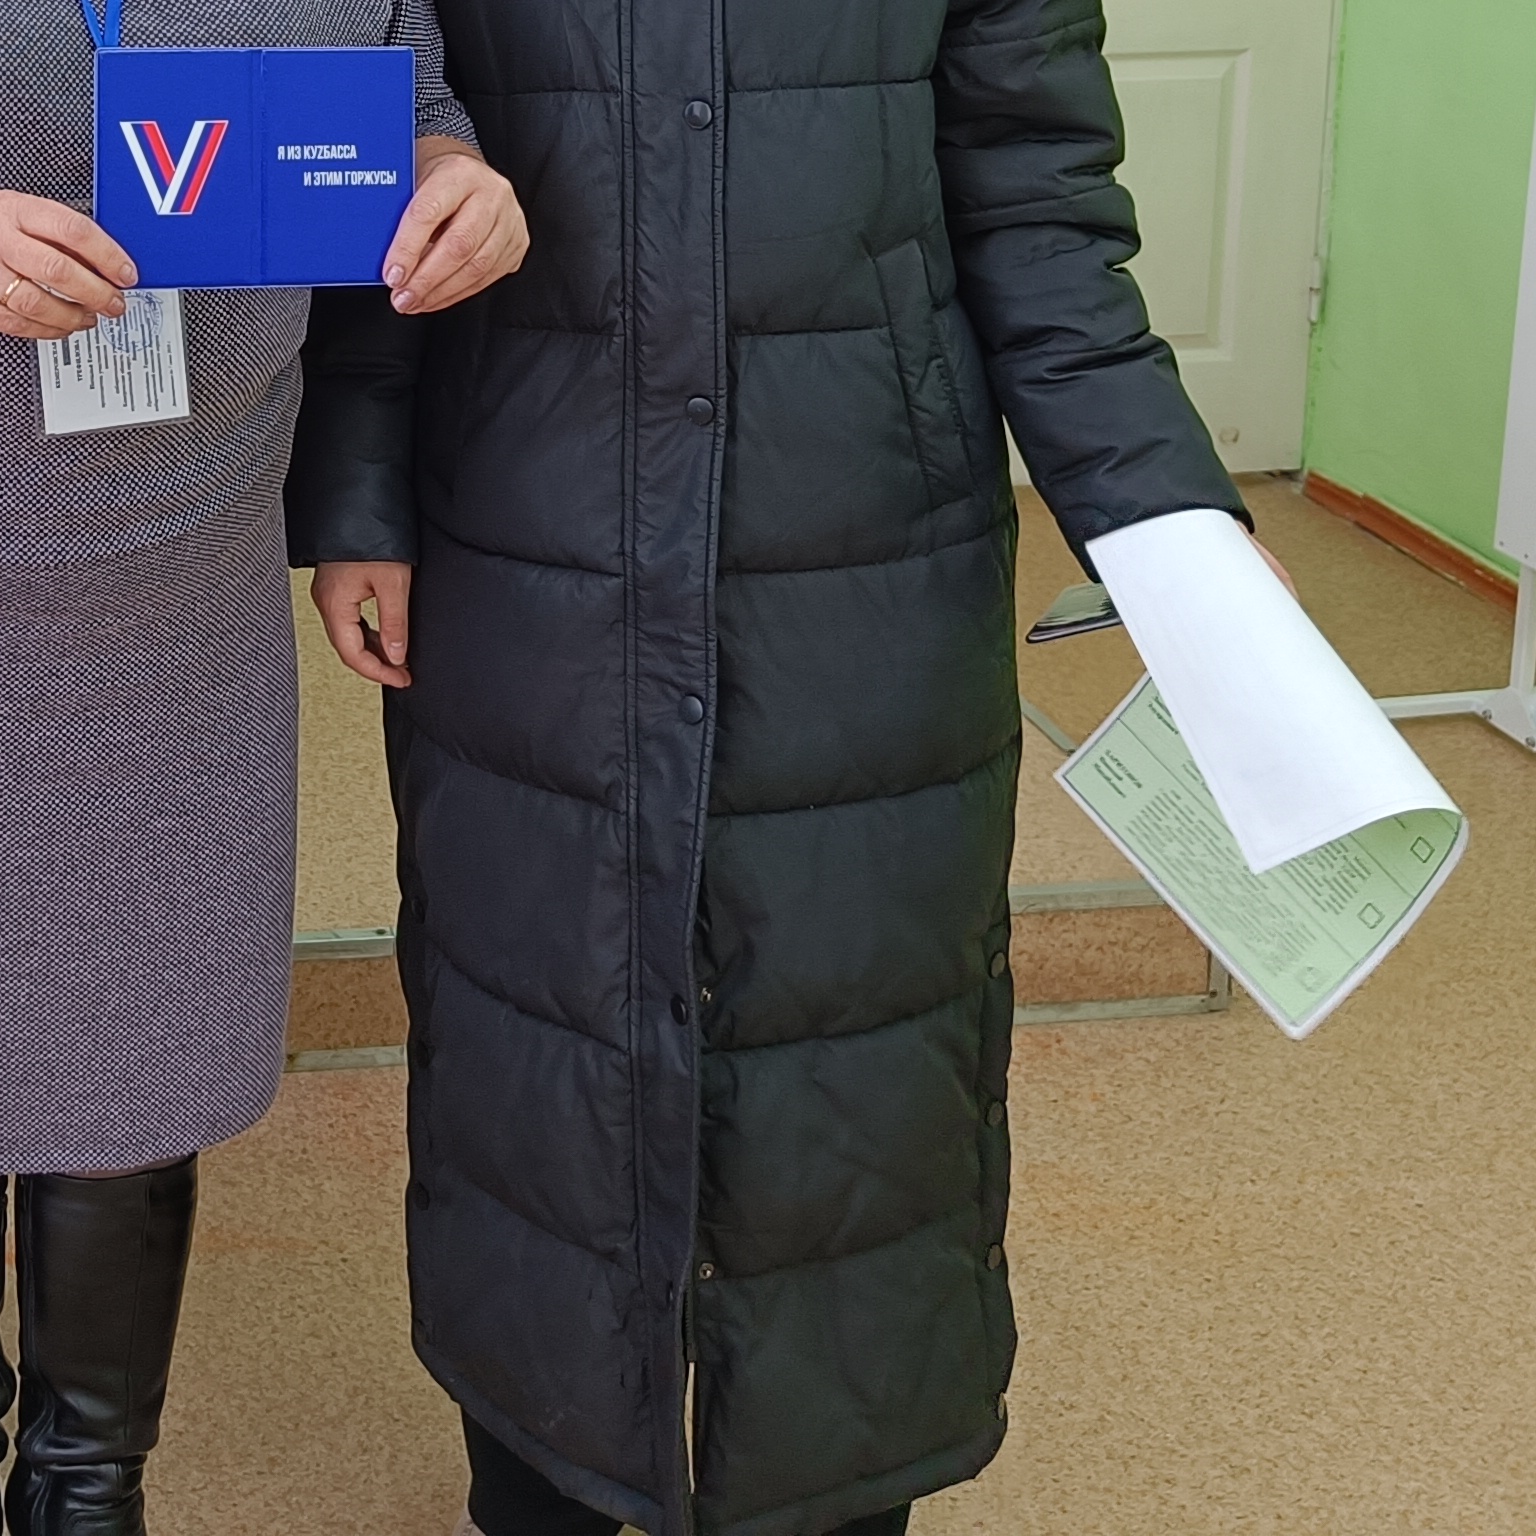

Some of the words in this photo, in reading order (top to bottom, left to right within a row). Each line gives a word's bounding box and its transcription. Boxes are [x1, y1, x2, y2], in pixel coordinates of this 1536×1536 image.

[277, 145, 285, 161] Я
[287, 145, 302, 160] ИЗ
[303, 171, 312, 187] И
[313, 170, 343, 186] ЭТИМ
